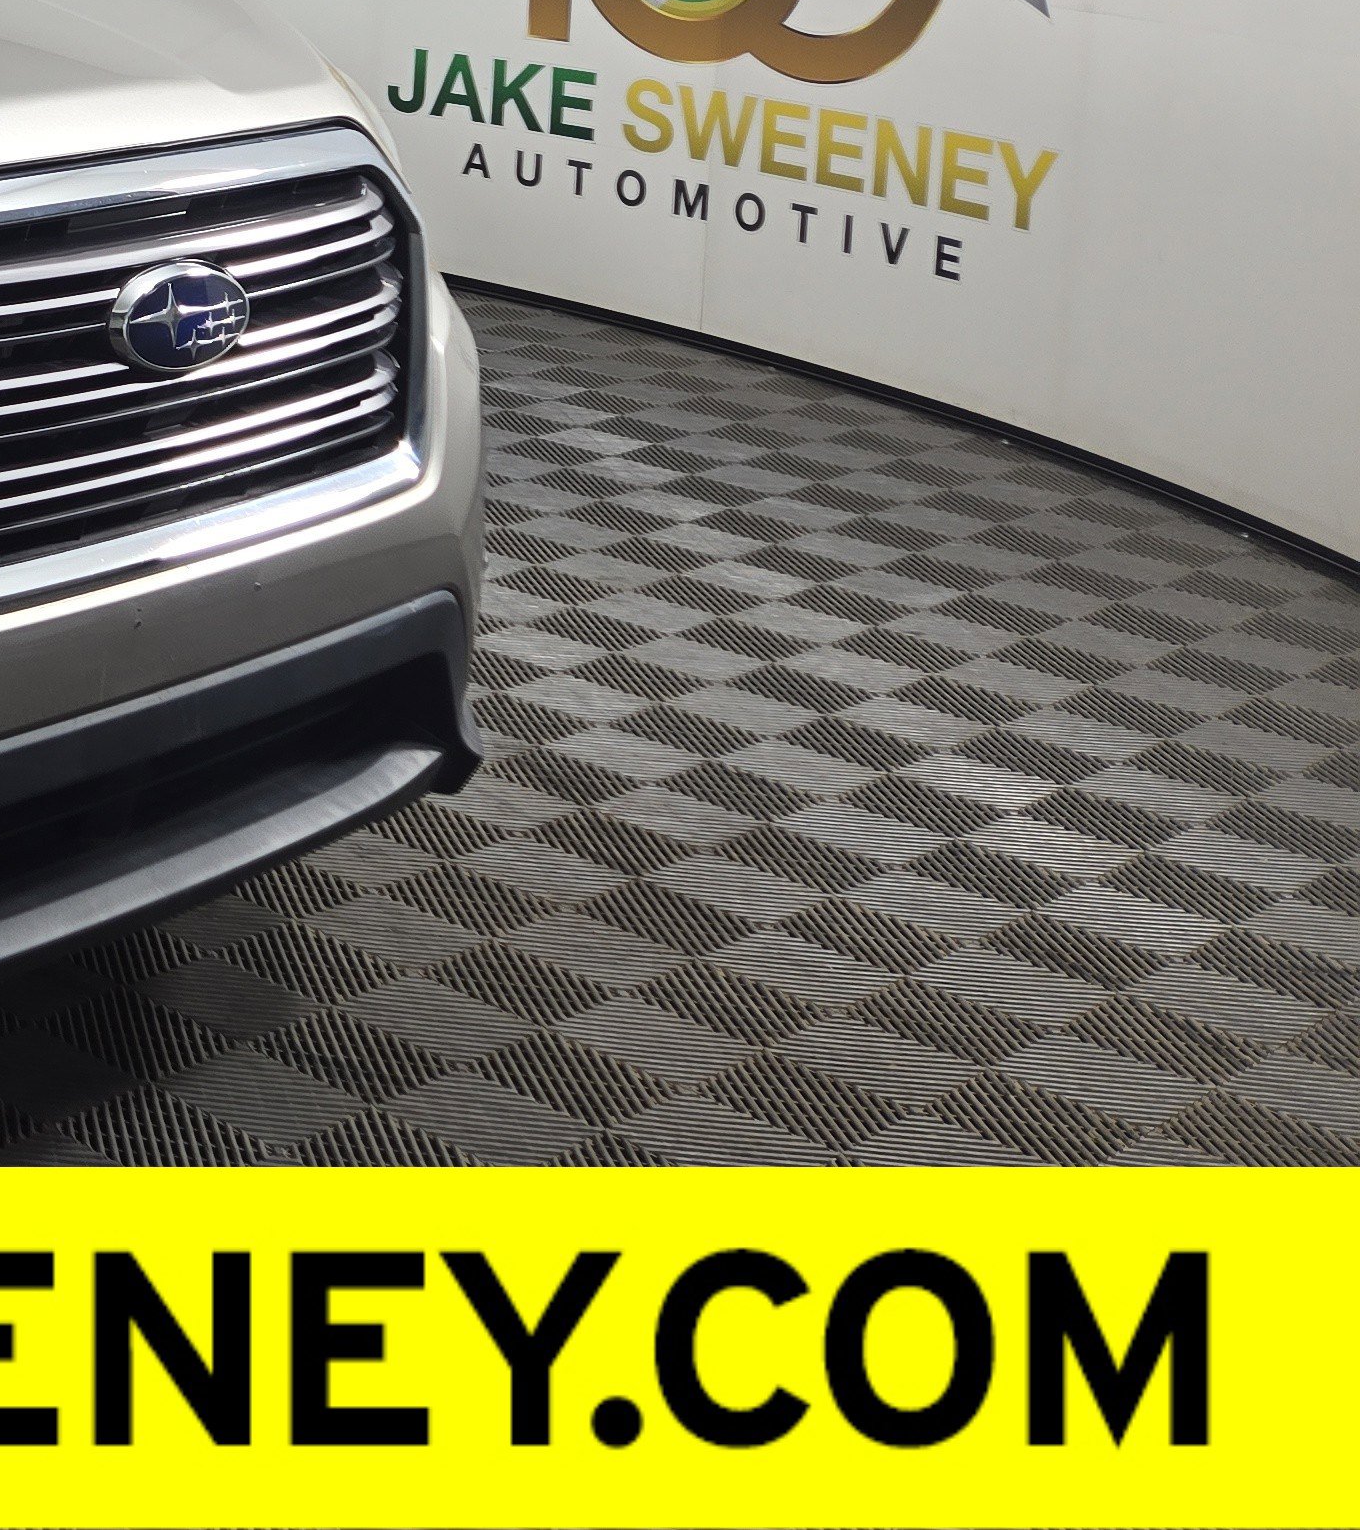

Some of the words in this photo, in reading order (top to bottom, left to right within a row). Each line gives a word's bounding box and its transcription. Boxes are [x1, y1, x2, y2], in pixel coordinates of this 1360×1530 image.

[388, 48, 597, 141] JAKE
[622, 78, 1059, 231] SWEENEY
[462, 143, 963, 281] AUTOMOTIVE
